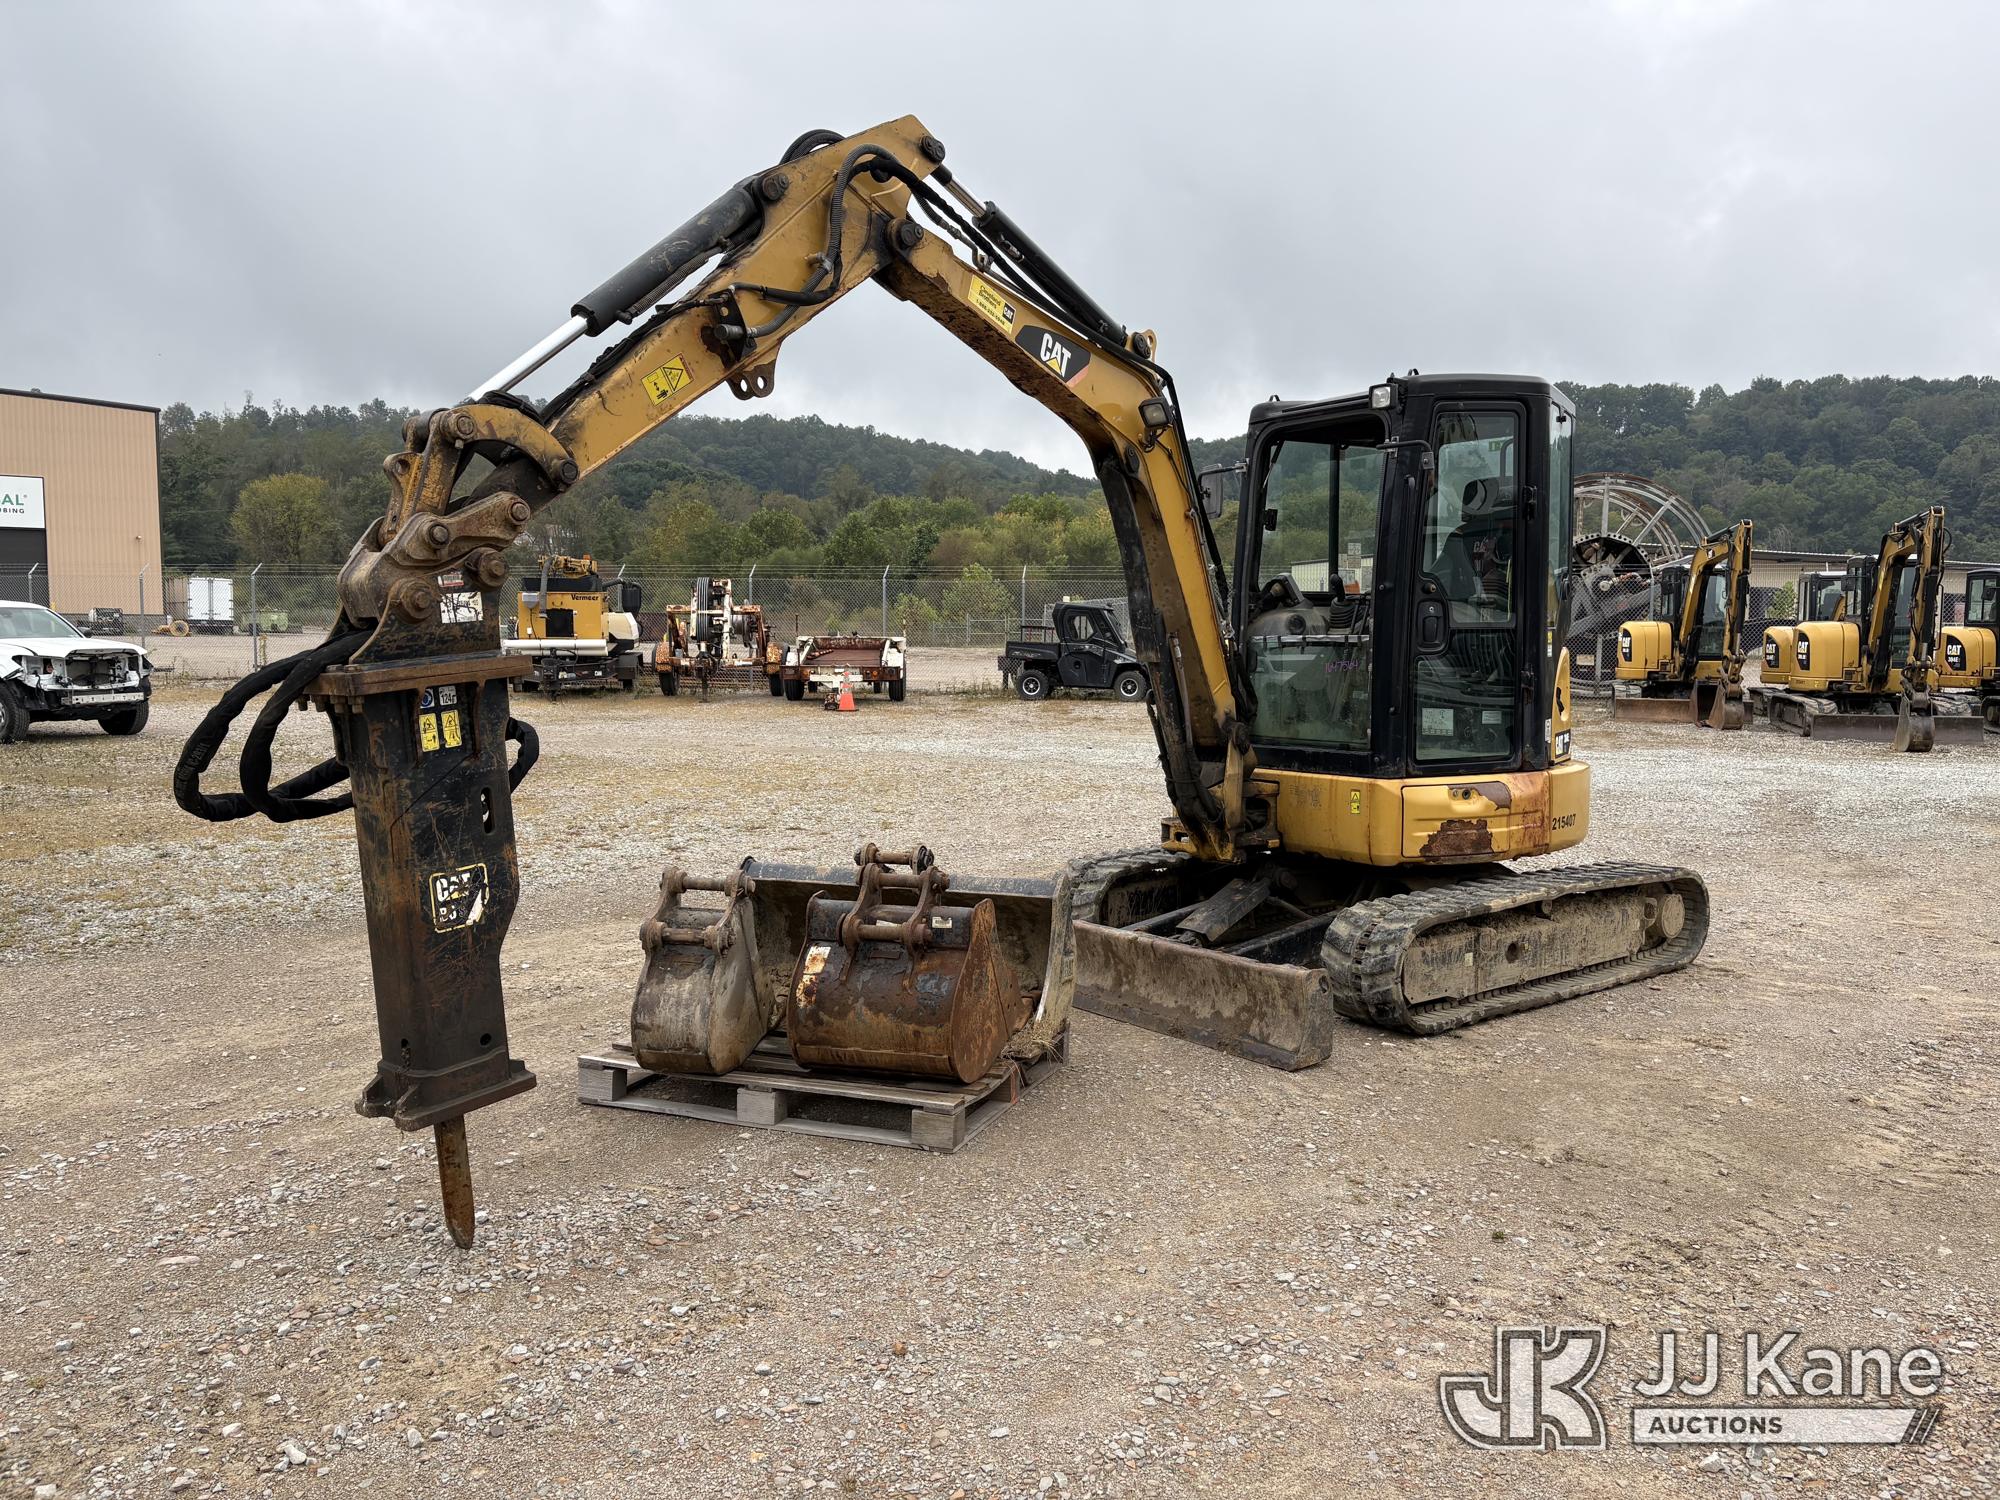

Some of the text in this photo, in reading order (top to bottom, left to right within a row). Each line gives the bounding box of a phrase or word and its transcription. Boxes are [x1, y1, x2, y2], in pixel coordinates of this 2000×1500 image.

[1040, 332, 1072, 378] CAT
[570, 593, 599, 601] Vermeer
[1766, 643, 1776, 654] CAT
[1797, 641, 1808, 653] CAT
[1947, 644, 1962, 655] CAT
[1552, 813, 1577, 831] 215407
